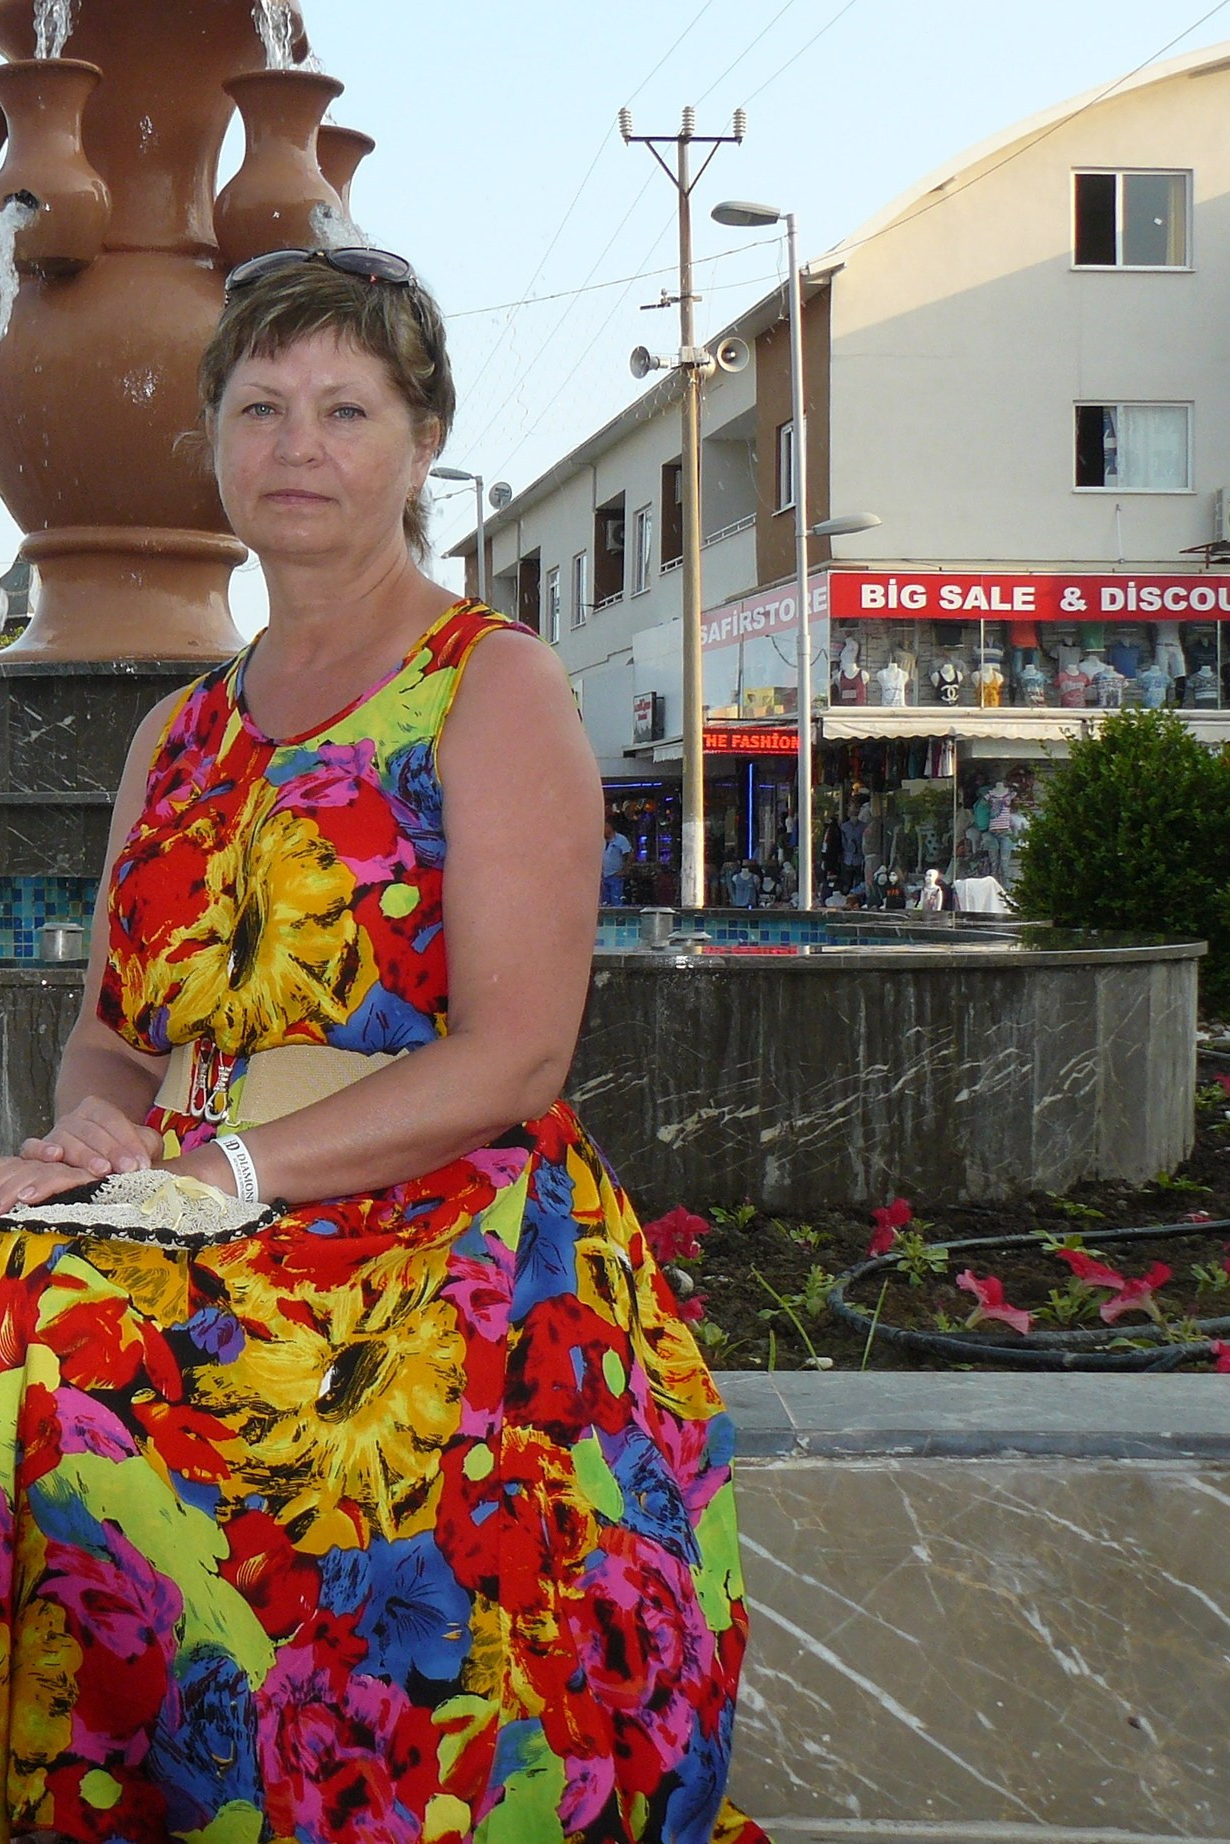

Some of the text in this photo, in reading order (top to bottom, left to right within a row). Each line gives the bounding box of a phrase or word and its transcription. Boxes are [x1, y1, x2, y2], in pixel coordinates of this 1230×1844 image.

[701, 586, 828, 645] SAFİRSTOE
[938, 584, 1036, 611] SALE
[1059, 587, 1088, 612] &
